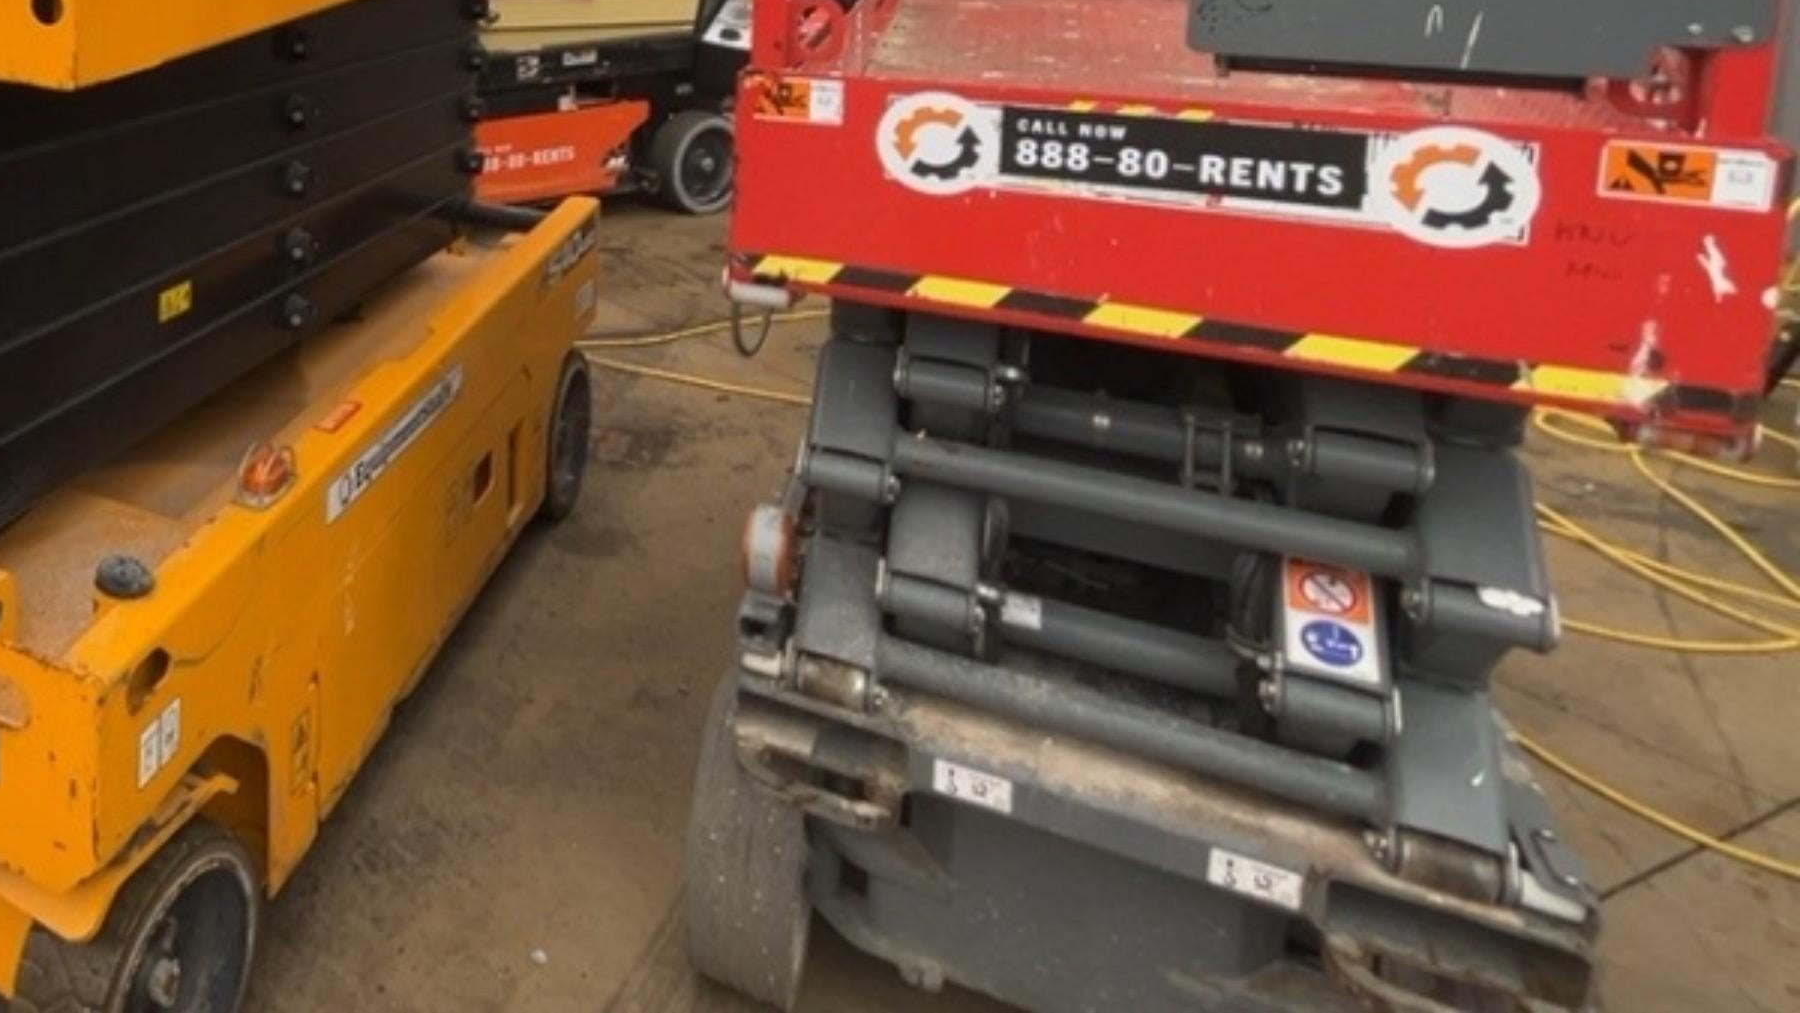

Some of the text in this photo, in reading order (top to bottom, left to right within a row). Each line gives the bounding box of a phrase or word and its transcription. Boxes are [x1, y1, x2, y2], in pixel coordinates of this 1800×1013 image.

[1016, 118, 1127, 140] CALL NOW
[1014, 138, 1344, 196] 888-80-RENTS
